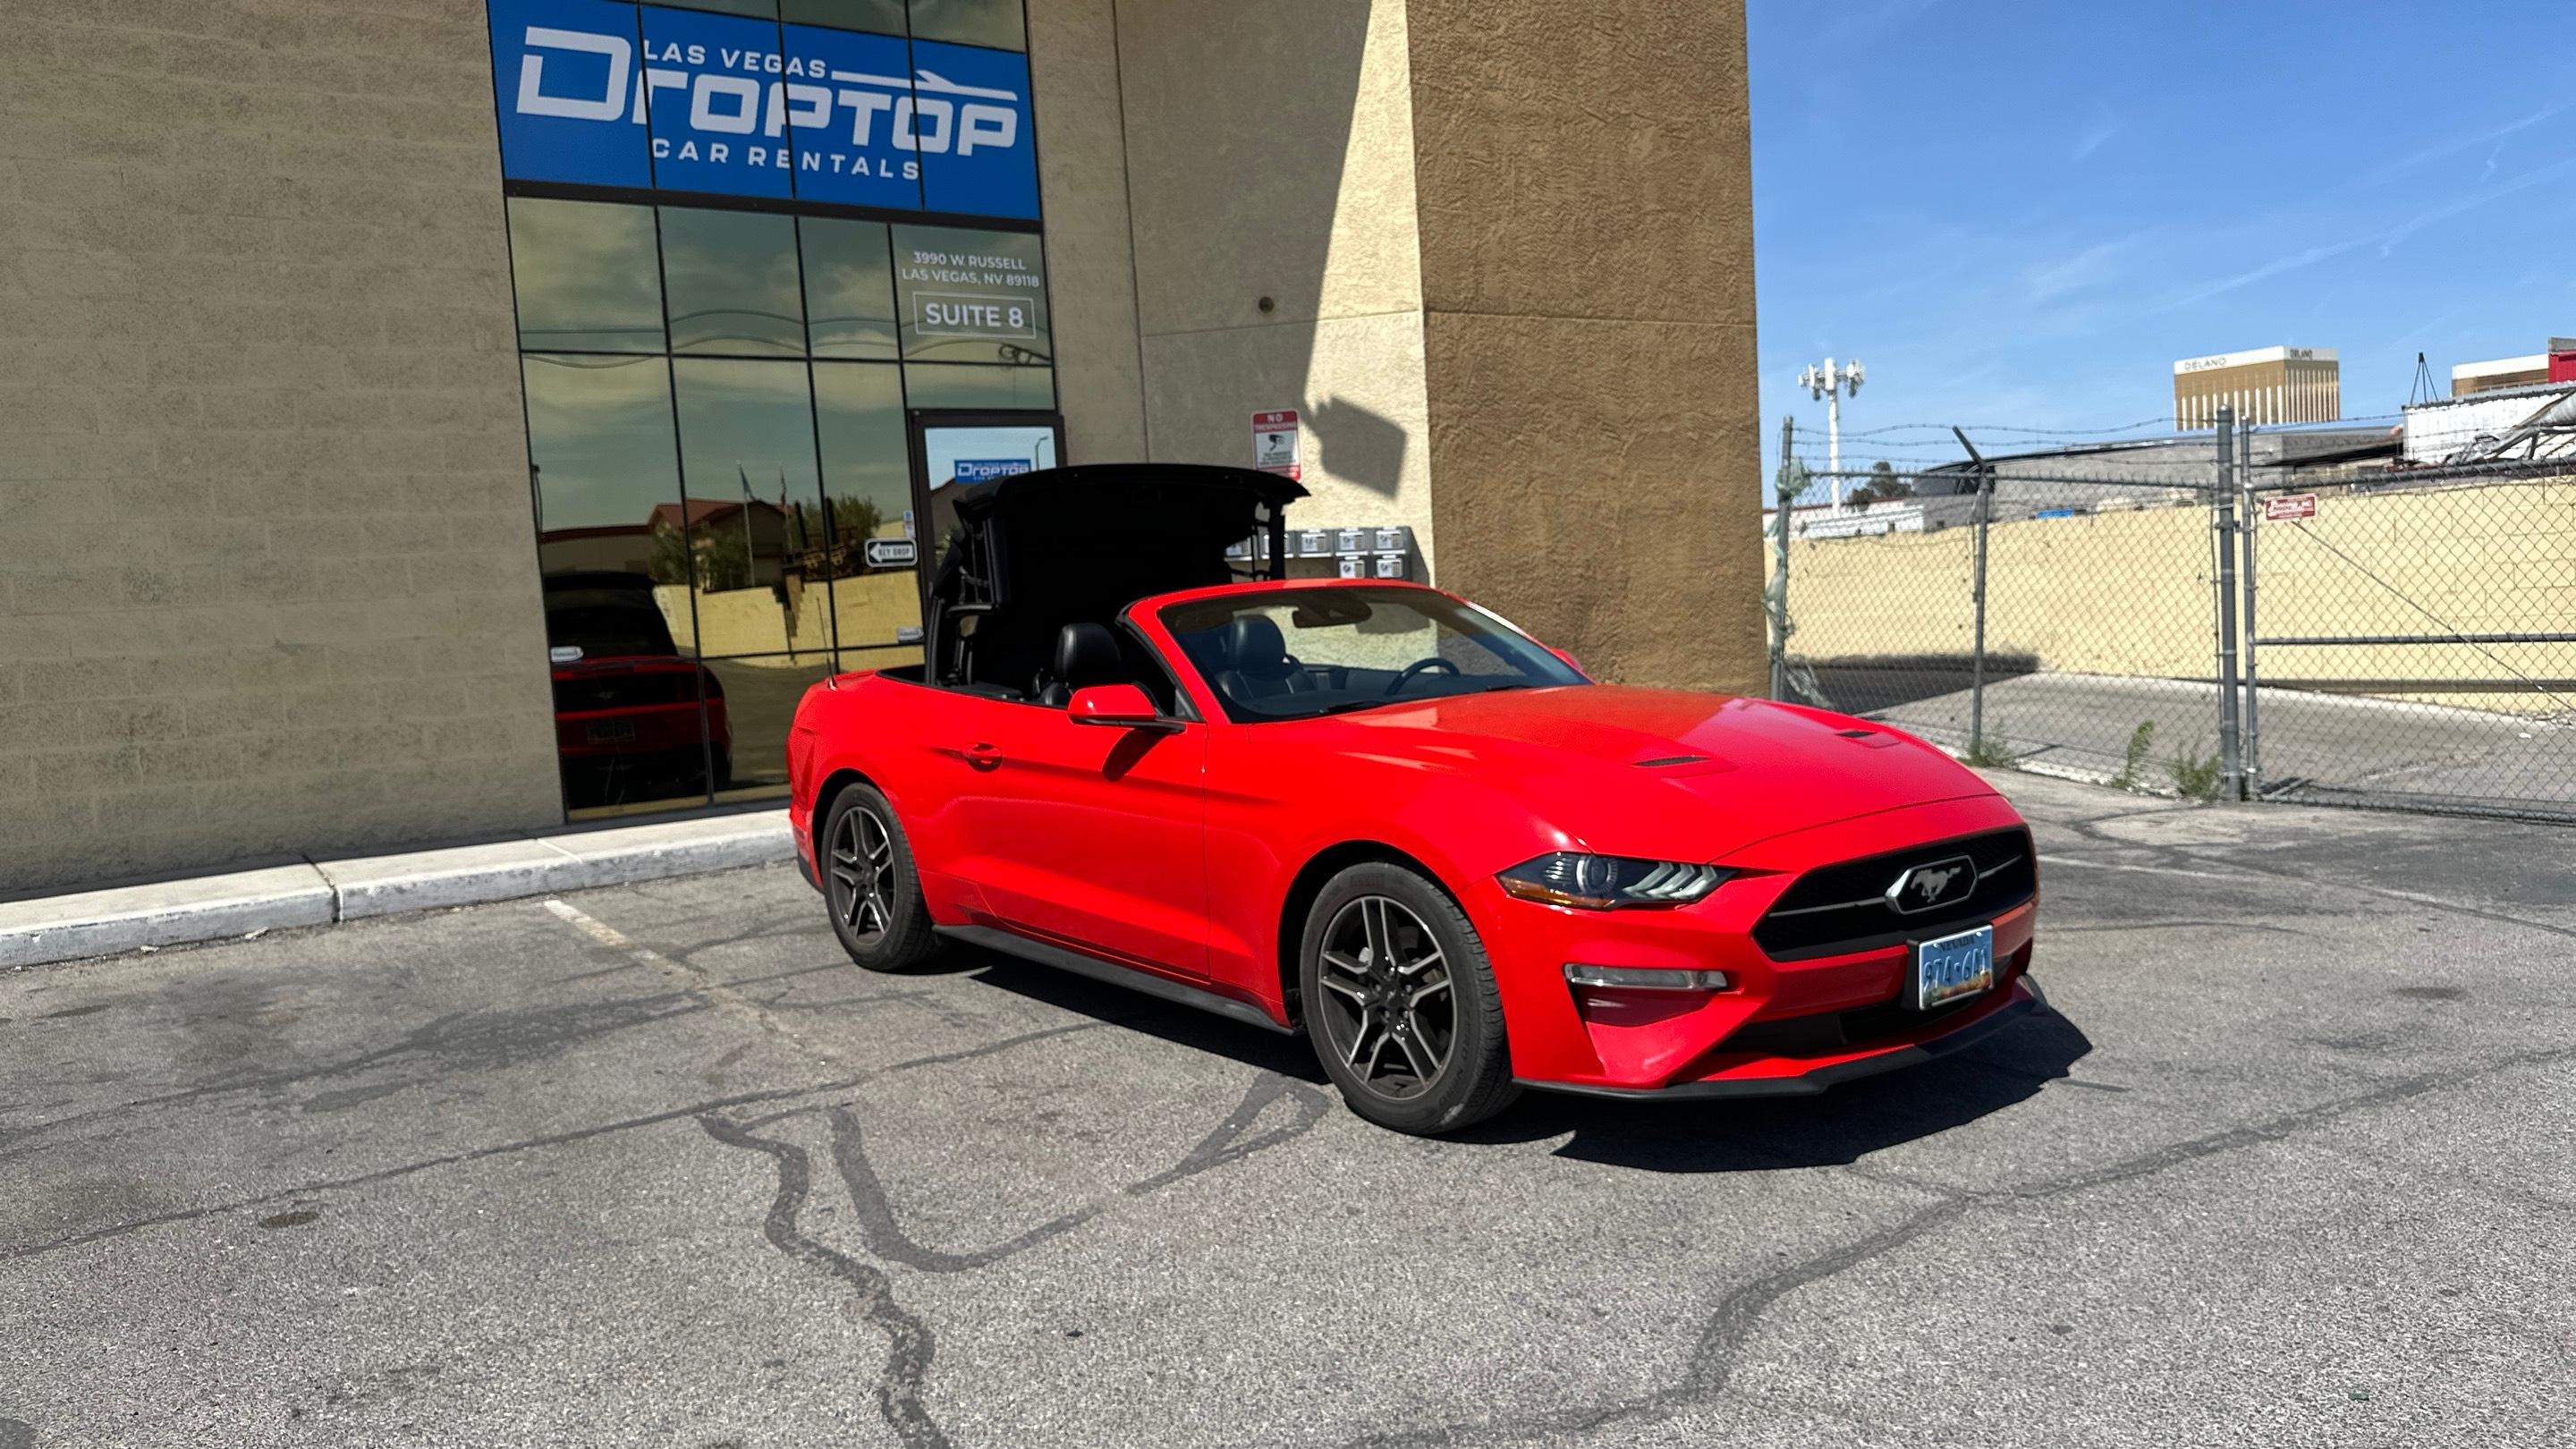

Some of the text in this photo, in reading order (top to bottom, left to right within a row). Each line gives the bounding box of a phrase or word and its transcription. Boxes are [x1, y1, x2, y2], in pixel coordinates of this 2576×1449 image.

[643, 39, 826, 79] LAS VEGAS
[652, 138, 919, 180] CAR RENTALS
[913, 251, 946, 265] 3990
[968, 255, 1027, 270] RUSSELL
[902, 268, 1039, 288] LAS VEGAS, NV 89118
[925, 302, 1024, 329] SUITE 8
[2183, 357, 2227, 371] DELANO
[1267, 413, 1284, 423] NO
